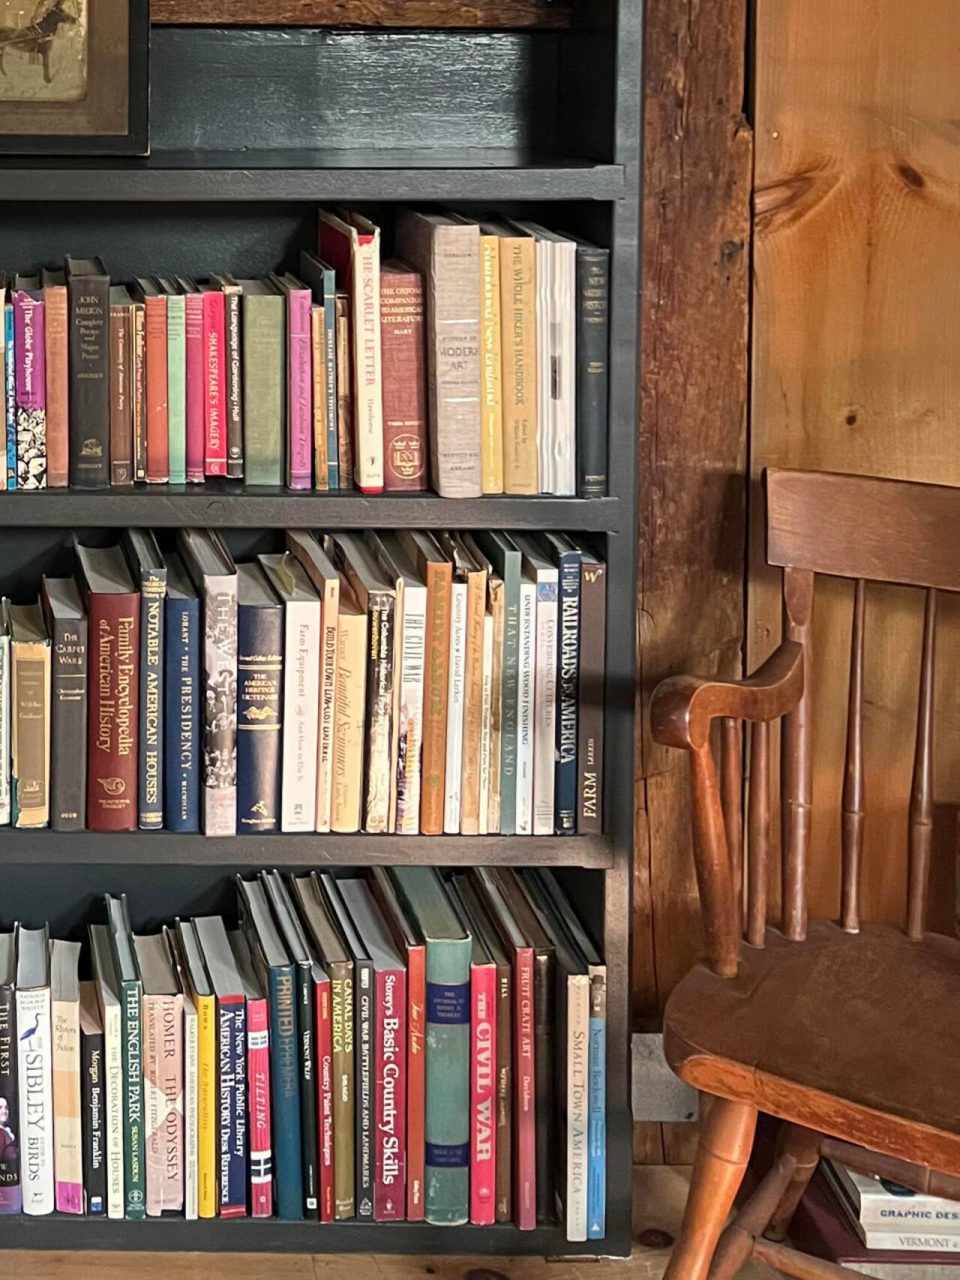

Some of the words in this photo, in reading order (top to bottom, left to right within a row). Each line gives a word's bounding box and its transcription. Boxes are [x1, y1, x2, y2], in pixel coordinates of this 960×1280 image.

[24, 309, 32, 324] The
[231, 296, 239, 309] The
[24, 327, 33, 349] Globe
[230, 311, 239, 349] Language
[24, 351, 33, 392] Playhouse
[208, 332, 219, 405] SHAKESPEARE'S
[231, 351, 239, 359] of
[230, 360, 239, 400] Gardening
[209, 408, 219, 450] IMAGERY
[231, 405, 239, 421] Hull
[99, 620, 109, 630] of
[116, 616, 134, 663] Family
[147, 601, 160, 666] NOTABLE
[405, 613, 424, 630] THE
[506, 604, 517, 647] THAT
[561, 596, 577, 679] RAILROADS
[99, 632, 115, 696] American
[404, 634, 424, 661] CIVIL
[403, 664, 421, 683] WAR
[506, 656, 516, 690] NEW
[97, 699, 115, 753] History
[116, 664, 133, 755] Encyclopedia
[146, 672, 159, 745] AMERICAN
[560, 696, 577, 763] AMERICA
[504, 699, 516, 776] ENGLAND
[145, 751, 158, 804] HOUSES
[583, 772, 596, 818] FARM
[127, 987, 139, 1018] THE
[276, 975, 293, 1036] PRINTED
[333, 980, 342, 993] IN
[343, 979, 352, 1023] CANAL
[383, 975, 397, 1016] Storey's
[477, 992, 486, 1018] THE
[0, 1001, 9, 1030] THE
[162, 1001, 175, 1059] HOMER
[333, 996, 343, 1053] AMERICA
[0, 1036, 10, 1076] FIRST
[128, 1021, 139, 1082] ENGLISH
[343, 1027, 353, 1053] DAYS
[382, 1017, 399, 1061] Basic
[476, 1022, 492, 1093] CIVIL
[572, 1031, 584, 1077] SMALL
[90, 1050, 100, 1083] Morgan
[279, 1037, 295, 1098] EPHEMERA
[25, 1054, 44, 1132] SIBLEY
[90, 1087, 101, 1128] Benjamin
[129, 1085, 140, 1123] PARK
[165, 1077, 176, 1108] THE
[255, 1072, 266, 1129] TILTING
[380, 1063, 399, 1134] Country
[572, 1081, 585, 1123] TOWN
[92, 1130, 101, 1169] Franklin
[130, 1126, 139, 1150] SUSAN
[165, 1112, 178, 1182] ODYSSEY
[476, 1096, 492, 1162] WAR
[28, 1136, 38, 1182] BIRDS
[131, 1151, 139, 1182] LASDUN
[382, 1137, 400, 1185] Skills
[572, 1127, 585, 1194] AMERICA
[880, 1209, 932, 1219] GRAPHIC
[899, 1236, 950, 1248] VERMONT
